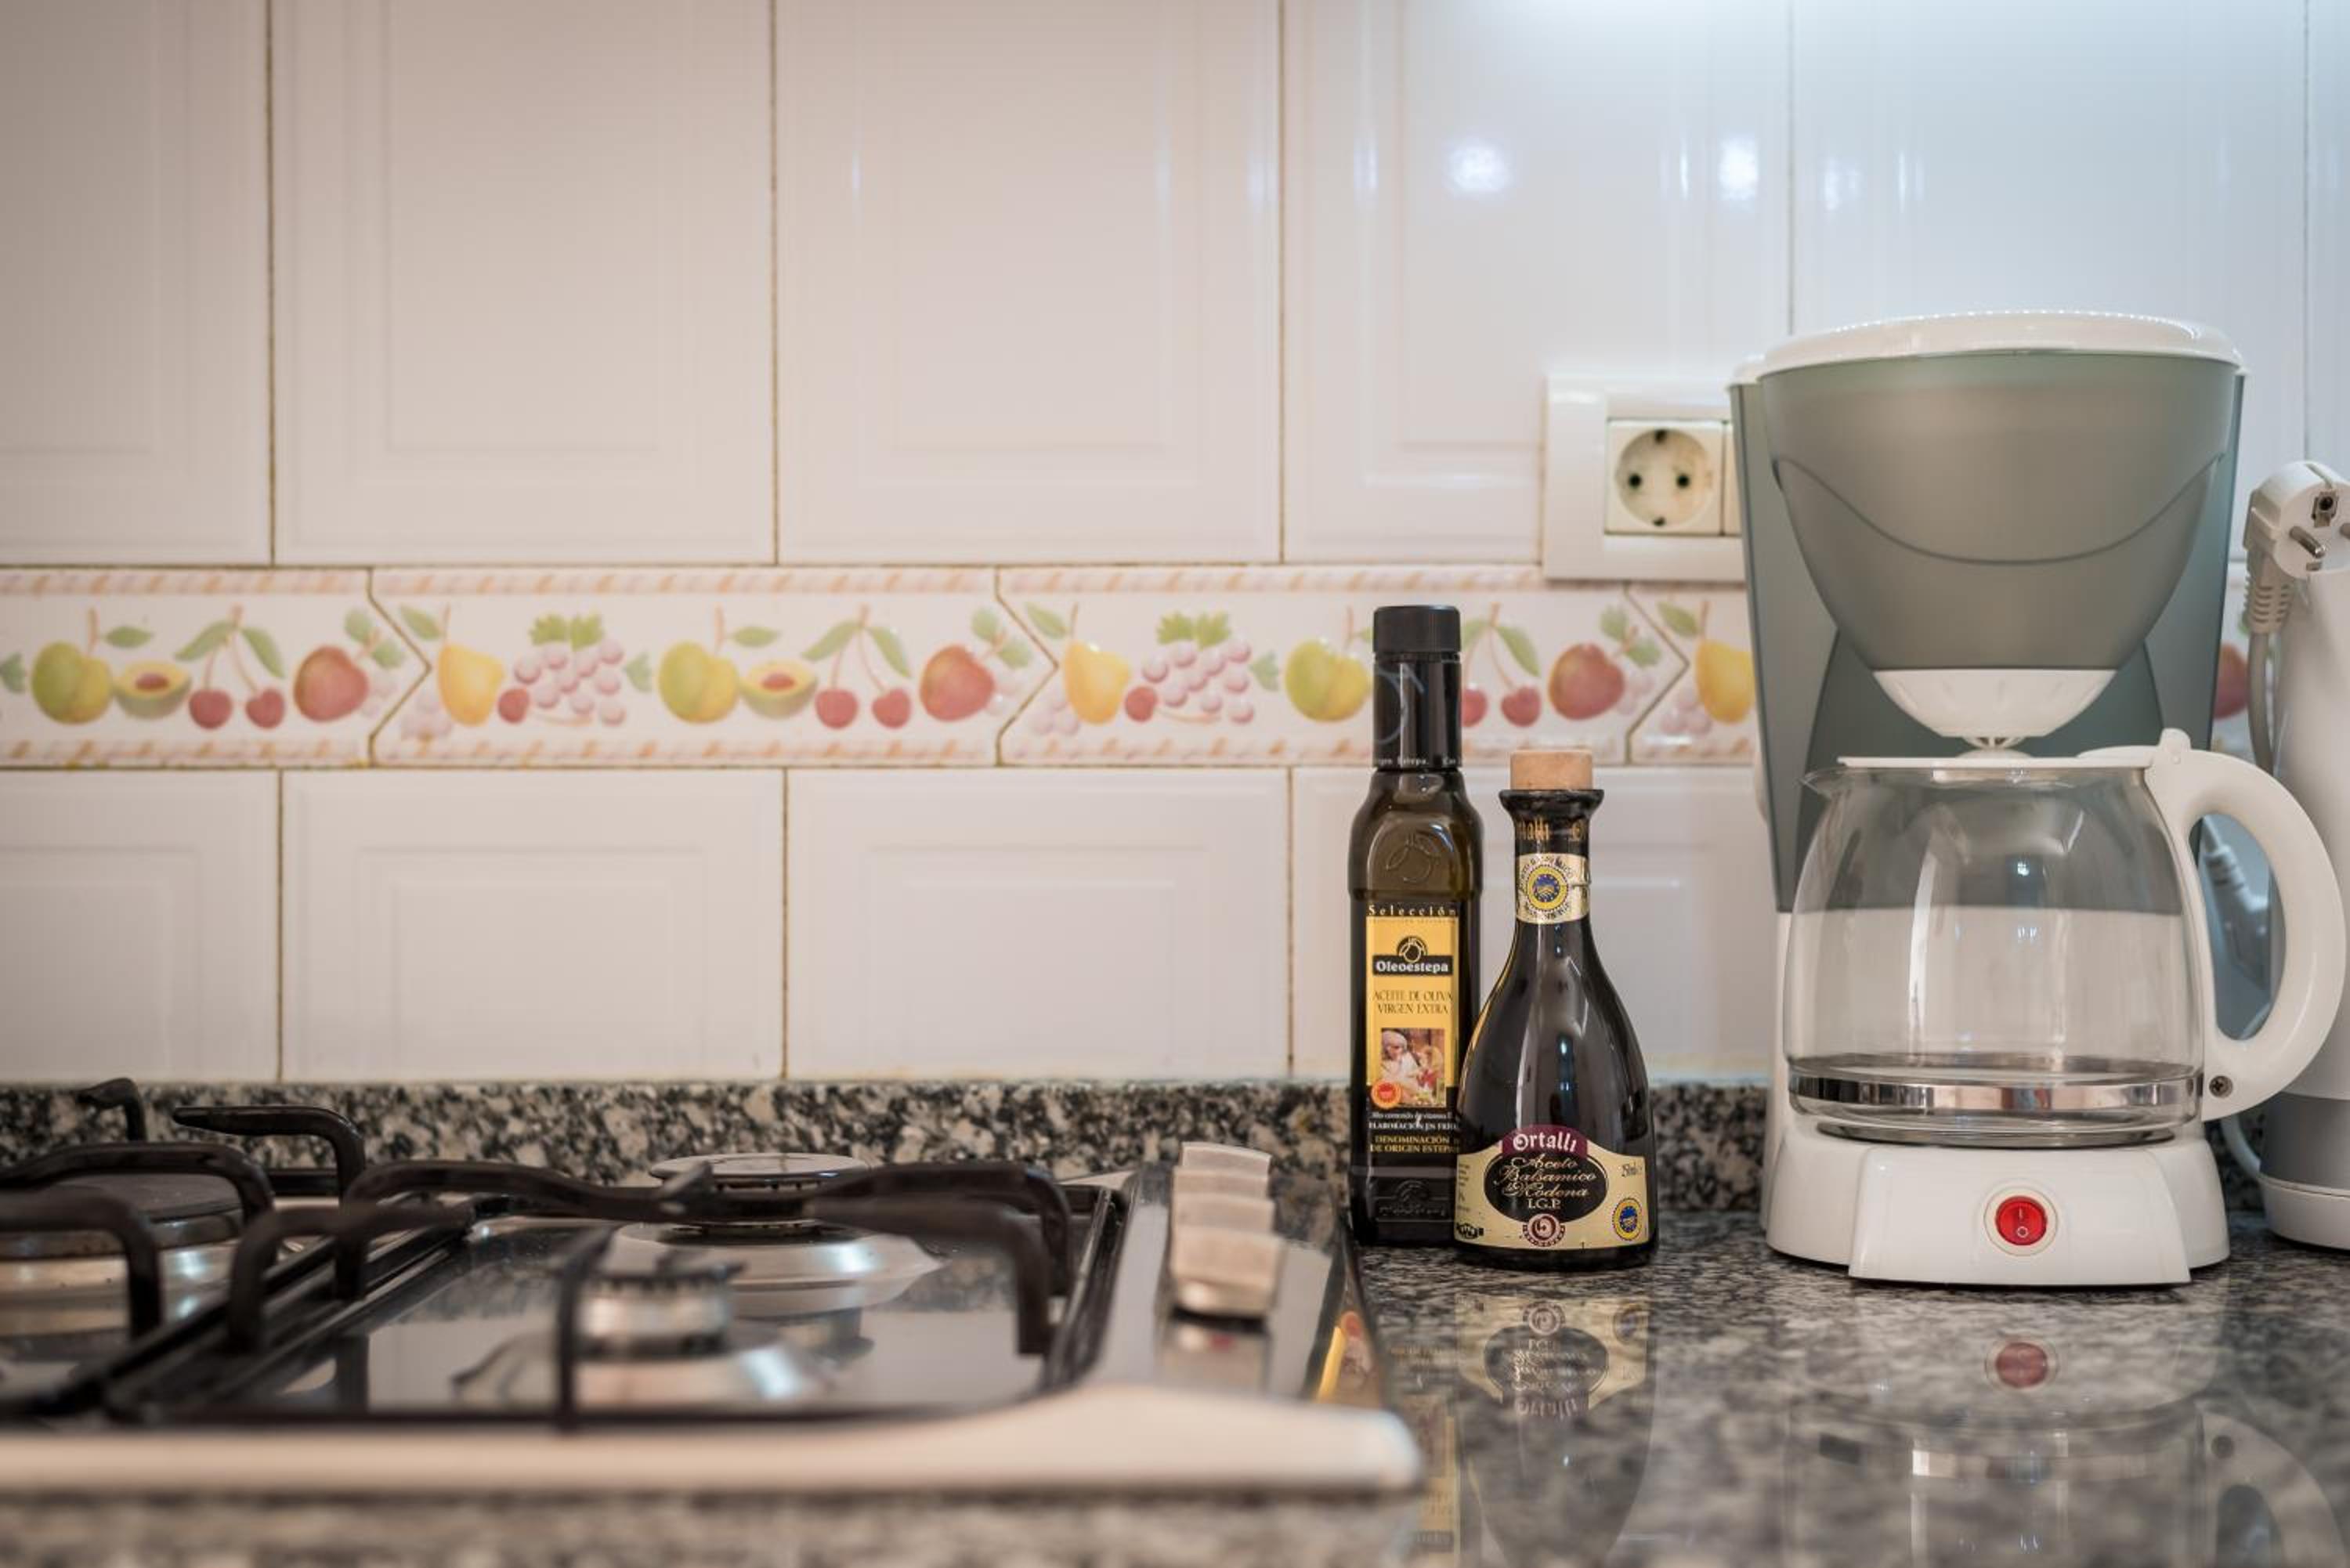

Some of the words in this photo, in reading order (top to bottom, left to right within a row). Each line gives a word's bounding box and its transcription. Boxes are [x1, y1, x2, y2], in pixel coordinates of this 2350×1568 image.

[1376, 960, 1448, 974] Oleoestepa
[1378, 1003, 1413, 1014] VIRGEN
[1417, 1003, 1449, 1015] EXTRA
[1513, 1132, 1577, 1152] Ortalli
